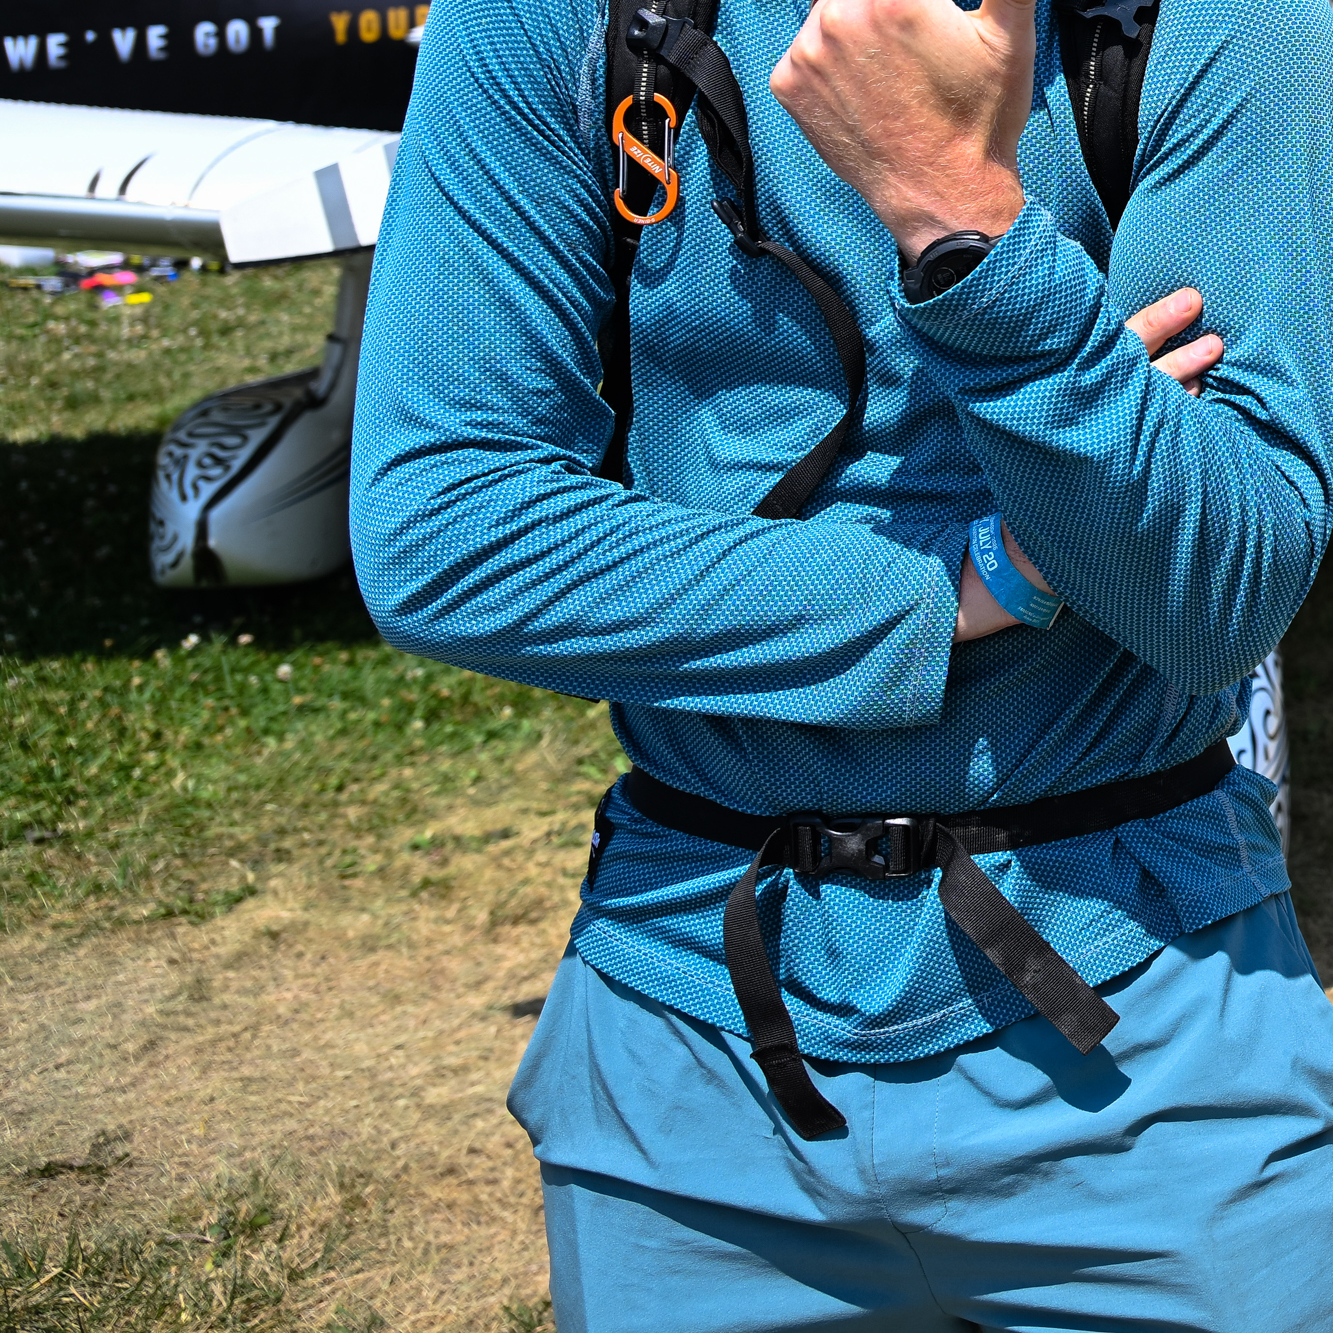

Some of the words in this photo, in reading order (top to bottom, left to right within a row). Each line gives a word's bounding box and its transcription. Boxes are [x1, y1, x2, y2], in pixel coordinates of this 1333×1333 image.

[3, 23, 170, 72] WE'VE
[193, 16, 283, 57] GOT
[978, 527, 992, 550] JULY
[982, 551, 999, 572] 20
